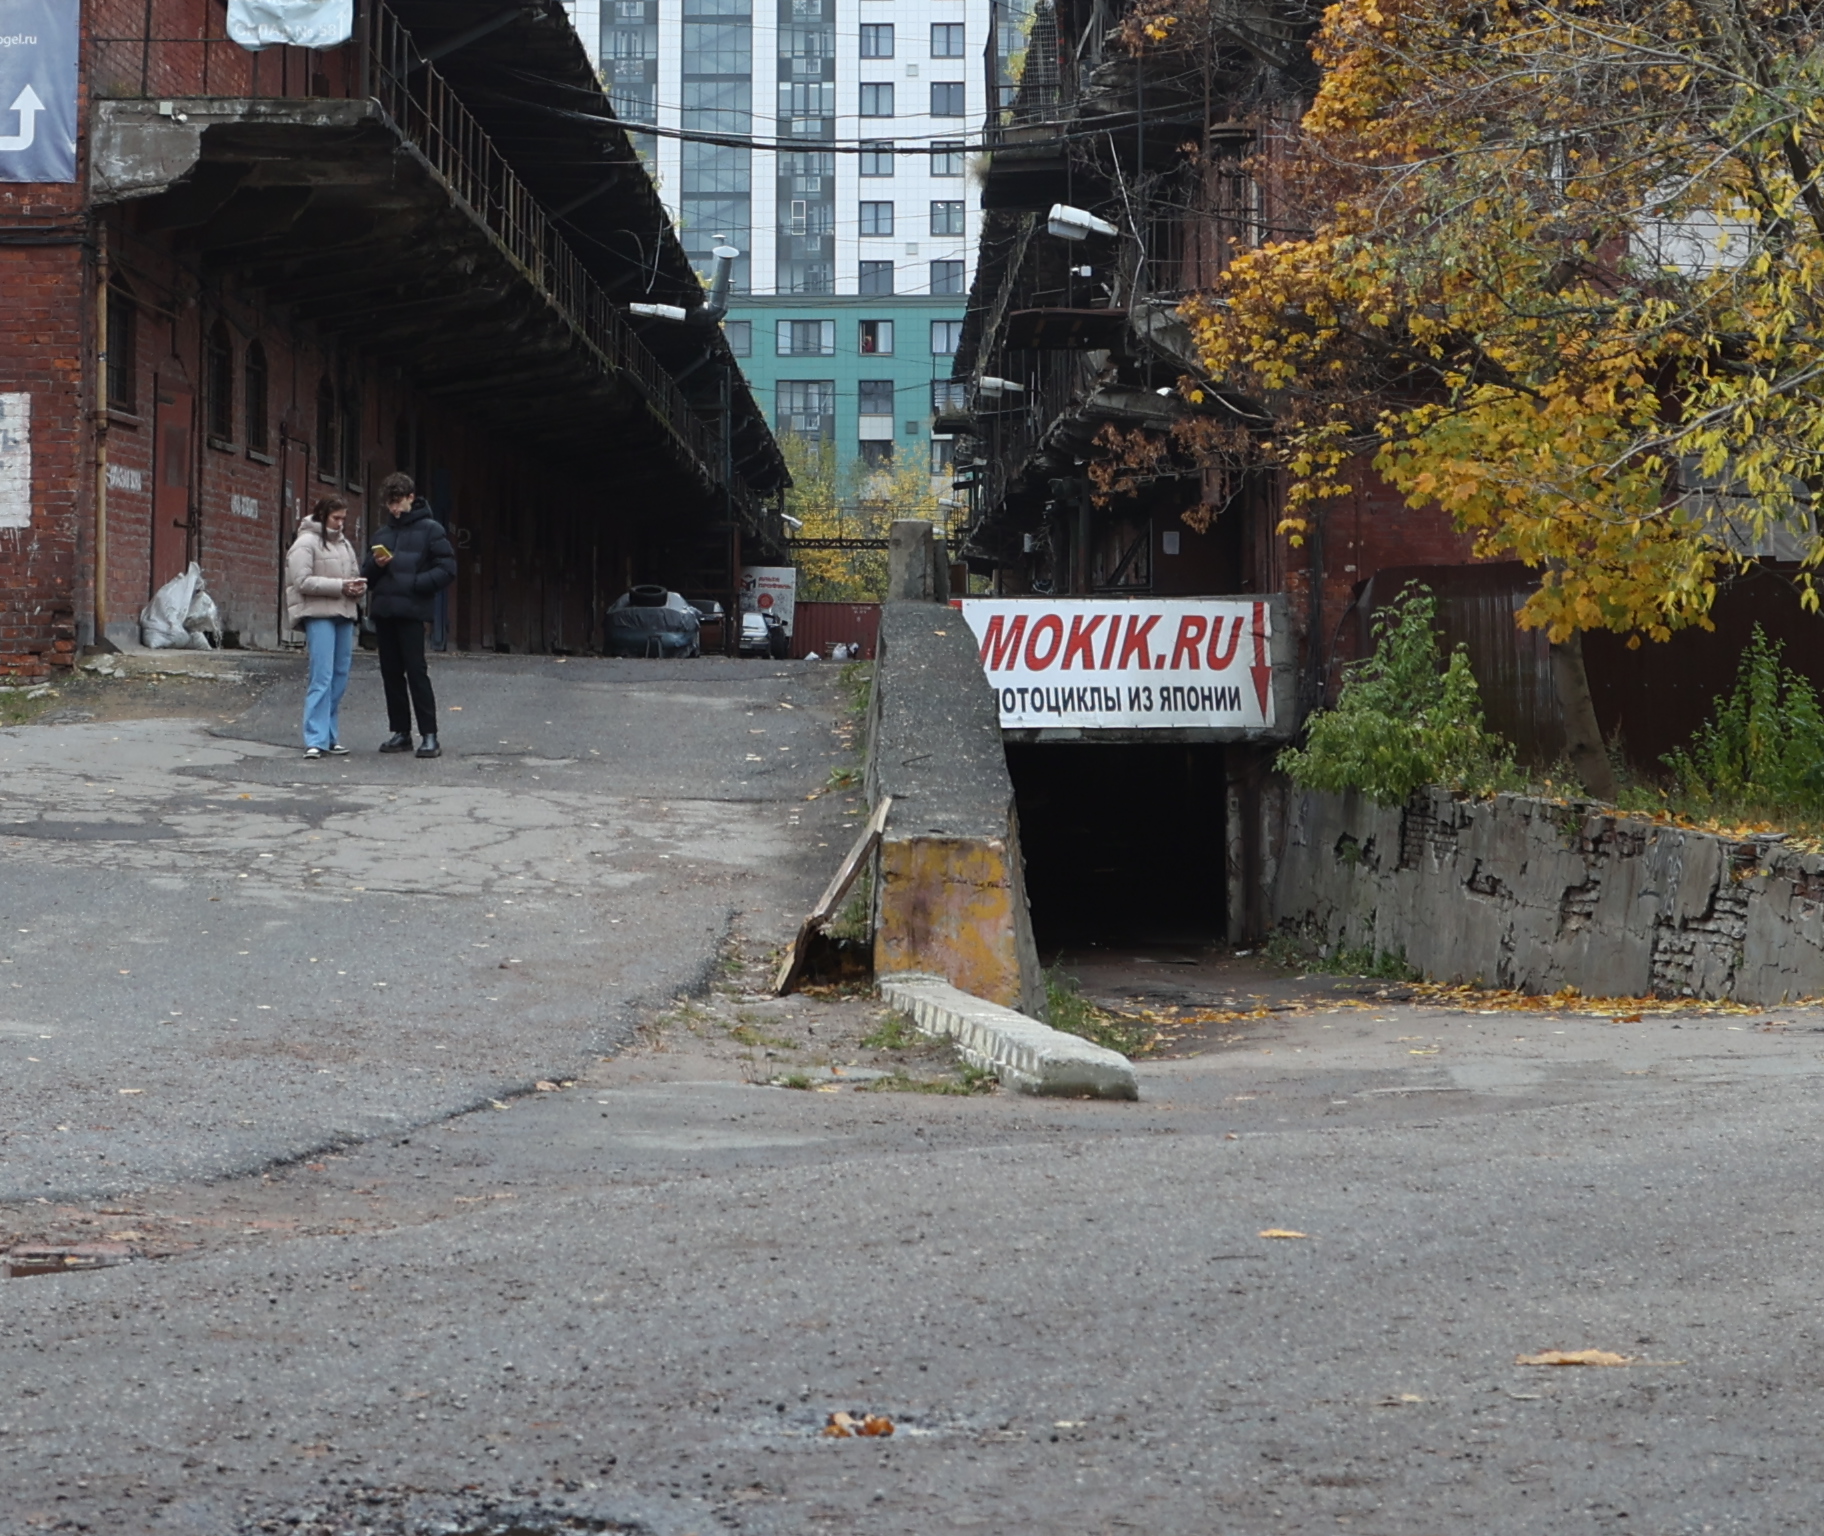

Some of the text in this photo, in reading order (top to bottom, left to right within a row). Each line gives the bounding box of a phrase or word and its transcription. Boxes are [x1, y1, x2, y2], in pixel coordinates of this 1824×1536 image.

[980, 614, 1244, 671] MOKIK.RU
[1129, 686, 1153, 712] ИЗ
[1160, 685, 1242, 712] ЯПОНИИ
